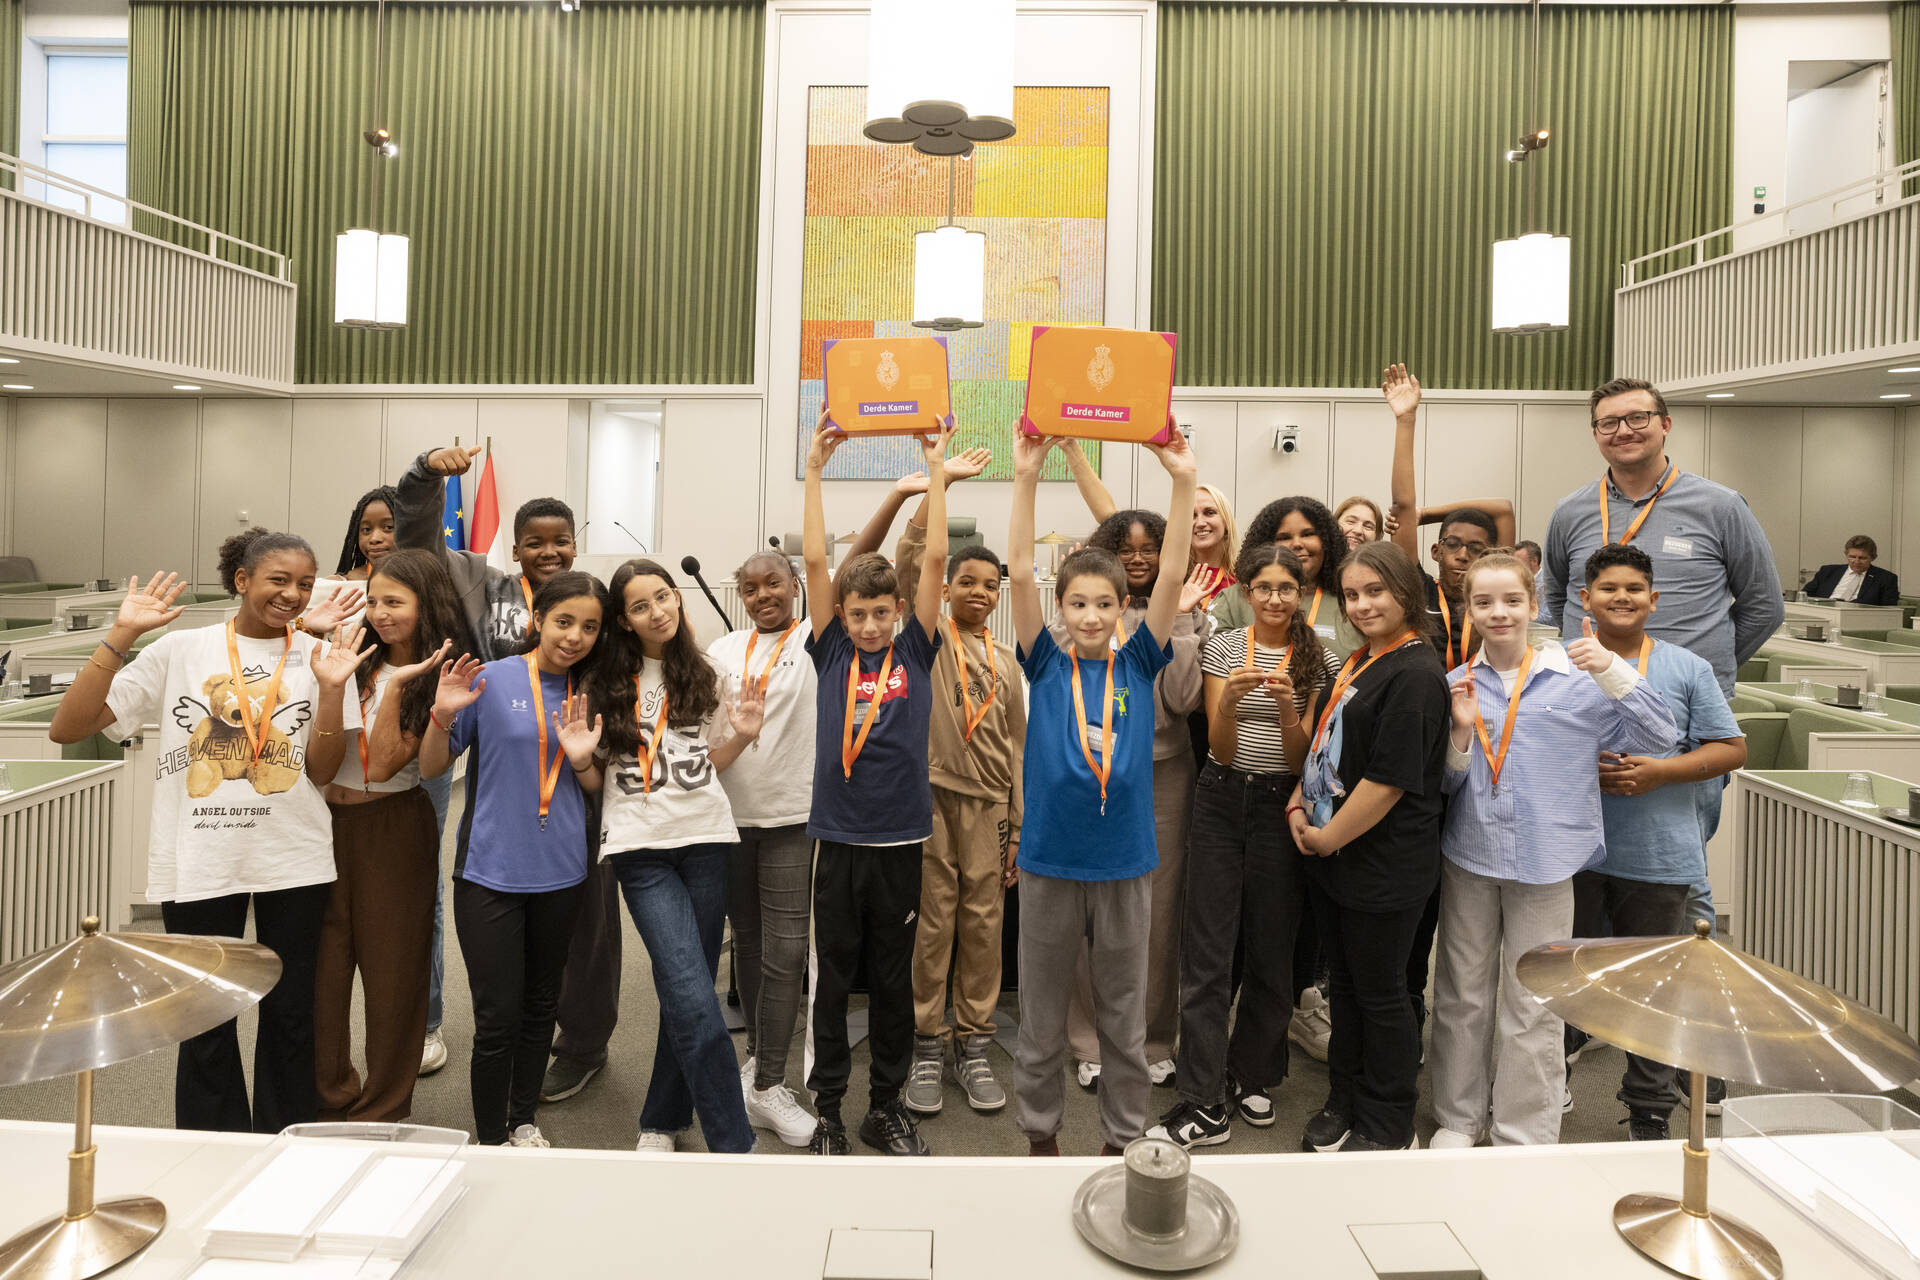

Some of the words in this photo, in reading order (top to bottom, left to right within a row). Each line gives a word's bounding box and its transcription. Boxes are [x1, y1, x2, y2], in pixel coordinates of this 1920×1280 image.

[863, 404, 887, 413] Derde
[888, 403, 913, 412] Kamer
[1066, 406, 1093, 417] Derde
[1095, 408, 1124, 419] Kamer
[156, 737, 248, 780] HEAVEN
[250, 739, 307, 774] MAD
[192, 807, 227, 816] ANGEL
[229, 806, 272, 816] OUTSIDE
[193, 818, 220, 831] devil
[223, 818, 258, 829] inside
